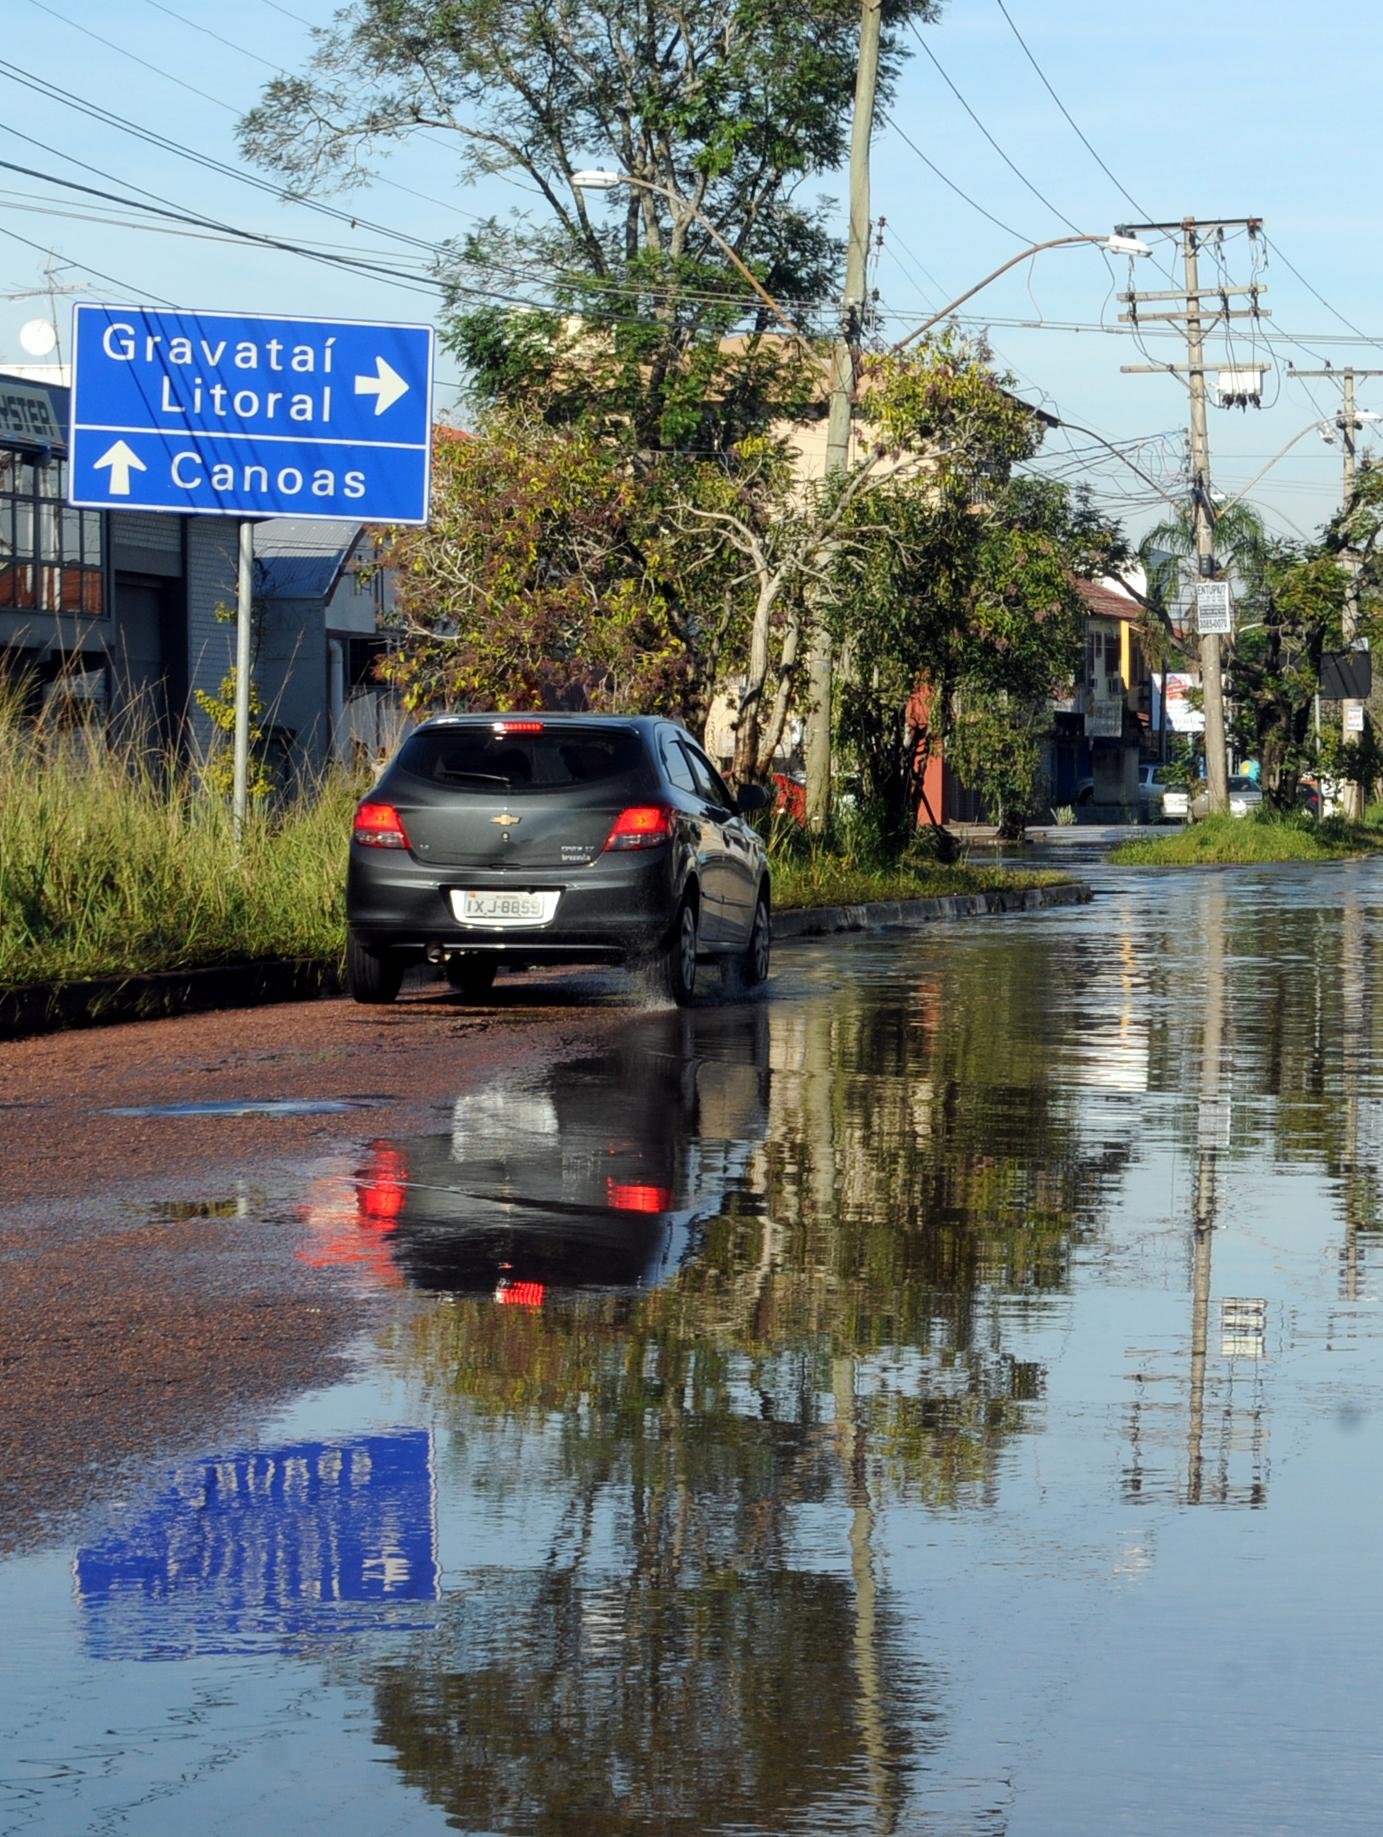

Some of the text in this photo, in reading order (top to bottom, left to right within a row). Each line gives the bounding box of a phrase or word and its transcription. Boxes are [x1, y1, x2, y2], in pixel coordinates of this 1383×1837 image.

[103, 323, 337, 373] Gravataí
[161, 376, 332, 422] Litoral
[171, 451, 366, 499] Canoas
